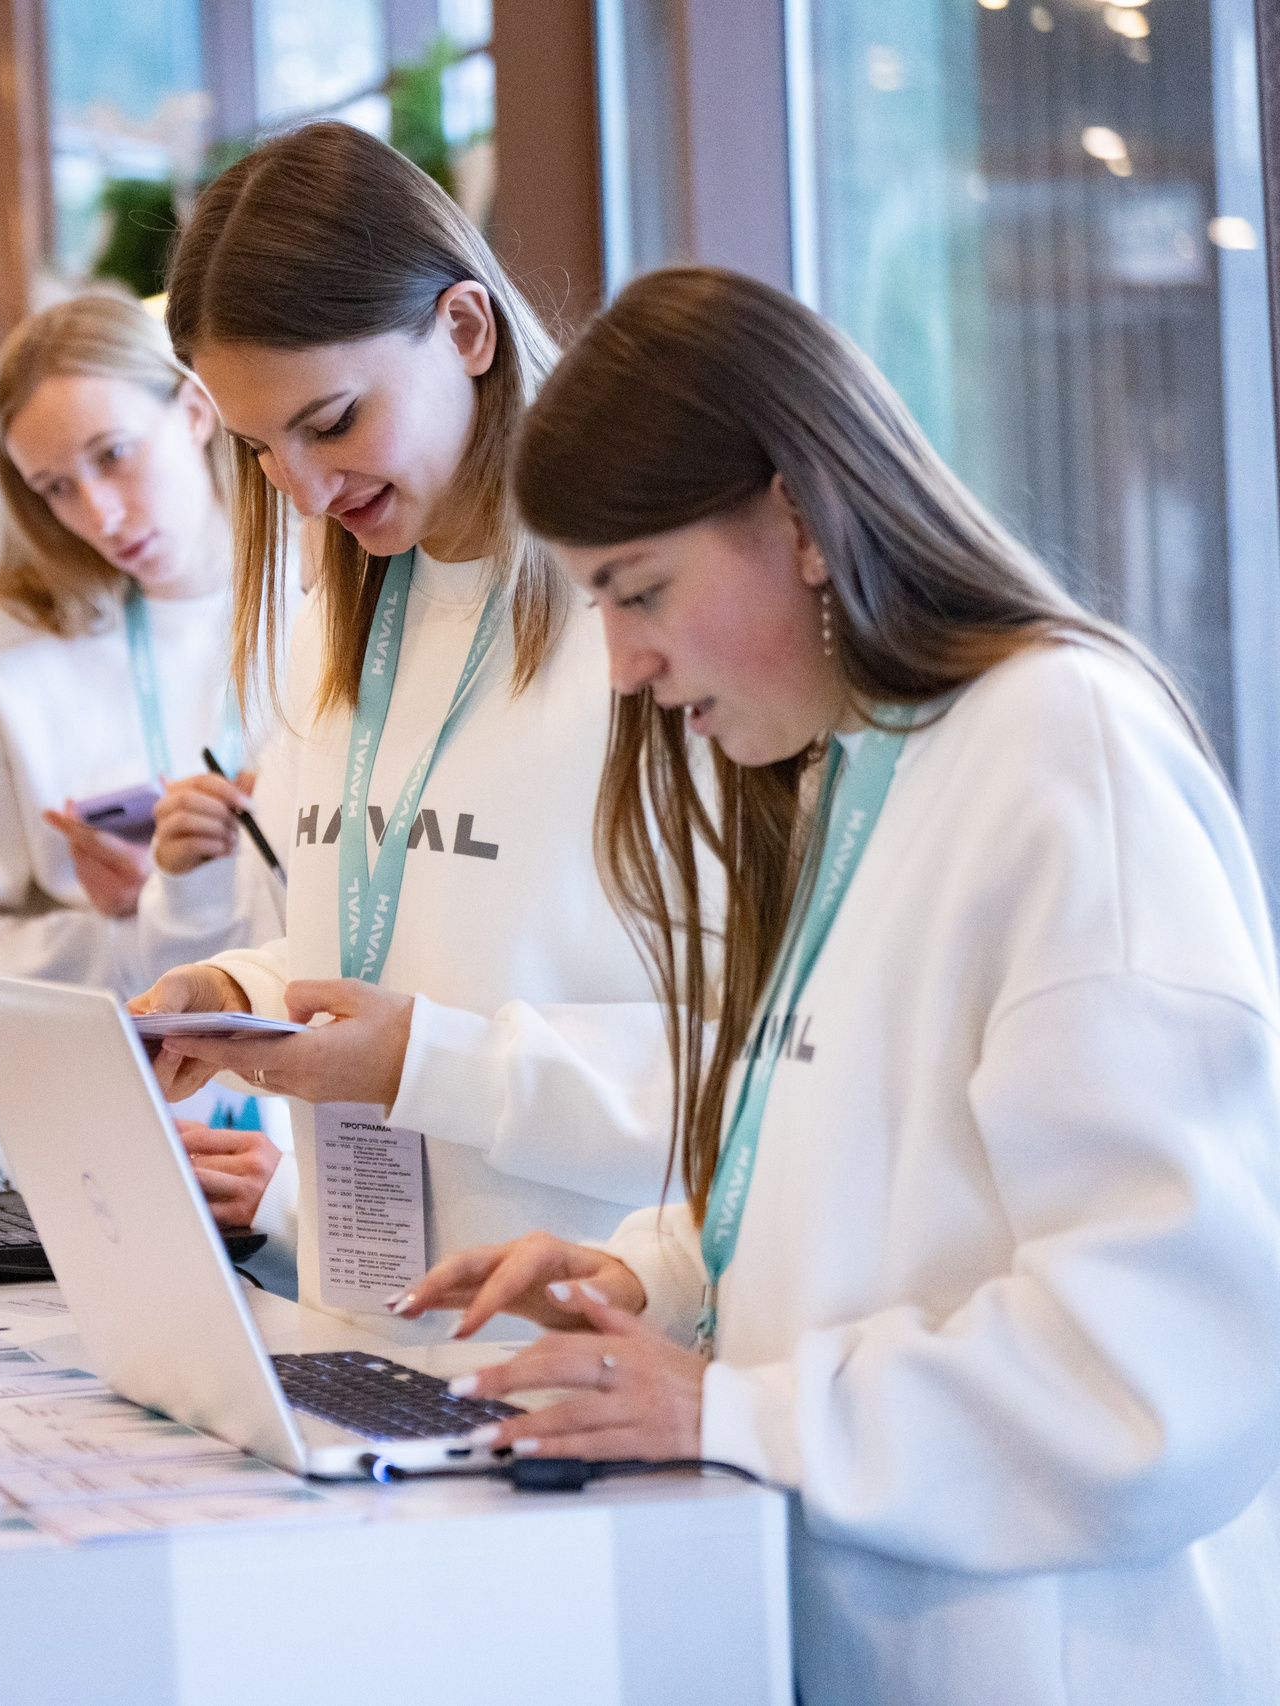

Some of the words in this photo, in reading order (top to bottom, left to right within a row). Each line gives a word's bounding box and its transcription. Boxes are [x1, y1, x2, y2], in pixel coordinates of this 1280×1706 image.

[371, 591, 398, 676] HAVAL
[348, 730, 372, 818] HAVAL
[347, 877, 361, 959] AVAL
[360, 893, 391, 980] HAVAL
[340, 1122, 391, 1133] ПРОГРАММА
[714, 1146, 750, 1245] HAVAL
